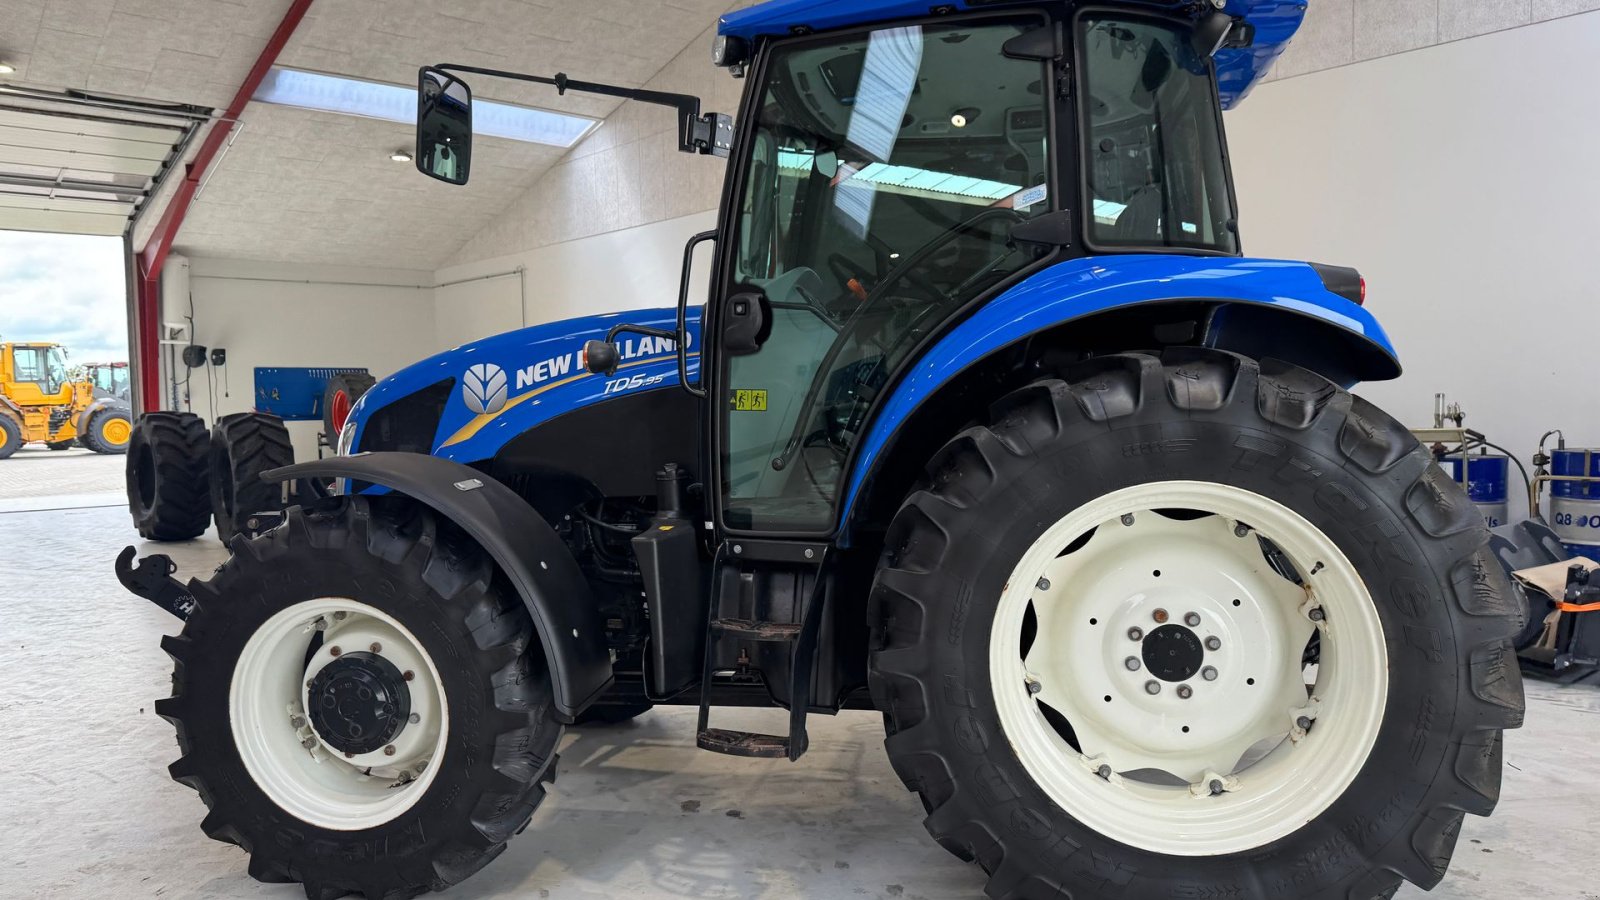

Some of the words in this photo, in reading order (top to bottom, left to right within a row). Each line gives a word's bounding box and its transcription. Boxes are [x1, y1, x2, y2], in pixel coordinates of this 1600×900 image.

[516, 352, 572, 390] NEW
[604, 373, 665, 395] TD5.95
[1555, 512, 1572, 526] Q8
